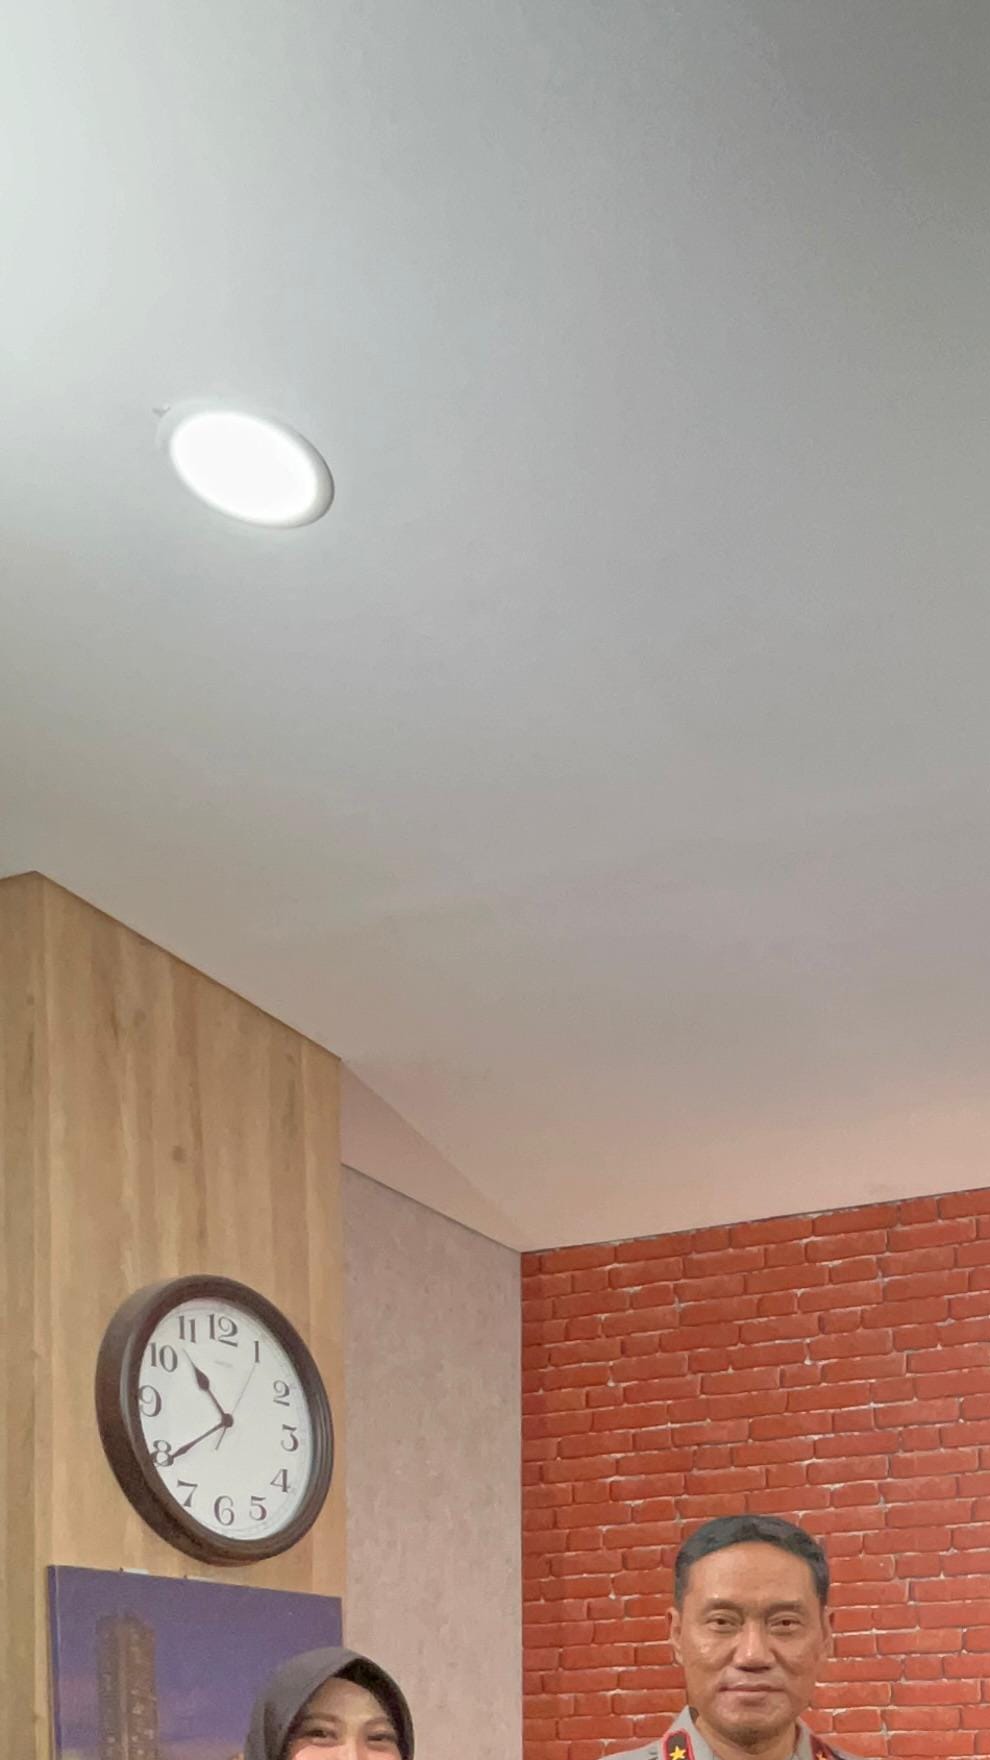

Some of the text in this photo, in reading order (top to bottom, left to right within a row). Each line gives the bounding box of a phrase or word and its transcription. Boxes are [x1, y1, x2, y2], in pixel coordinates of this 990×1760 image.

[178, 1315, 197, 1344] 11
[209, 1313, 238, 1347] 12
[150, 1342, 178, 1372] 10
[253, 1340, 261, 1364] 1
[139, 1385, 162, 1417] 9
[273, 1380, 290, 1407] 2
[281, 1424, 299, 1452] 3
[152, 1440, 173, 1467] 8
[177, 1480, 198, 1507] 7
[270, 1468, 291, 1493] 4
[214, 1495, 235, 1526] 6
[250, 1495, 267, 1521] 5
